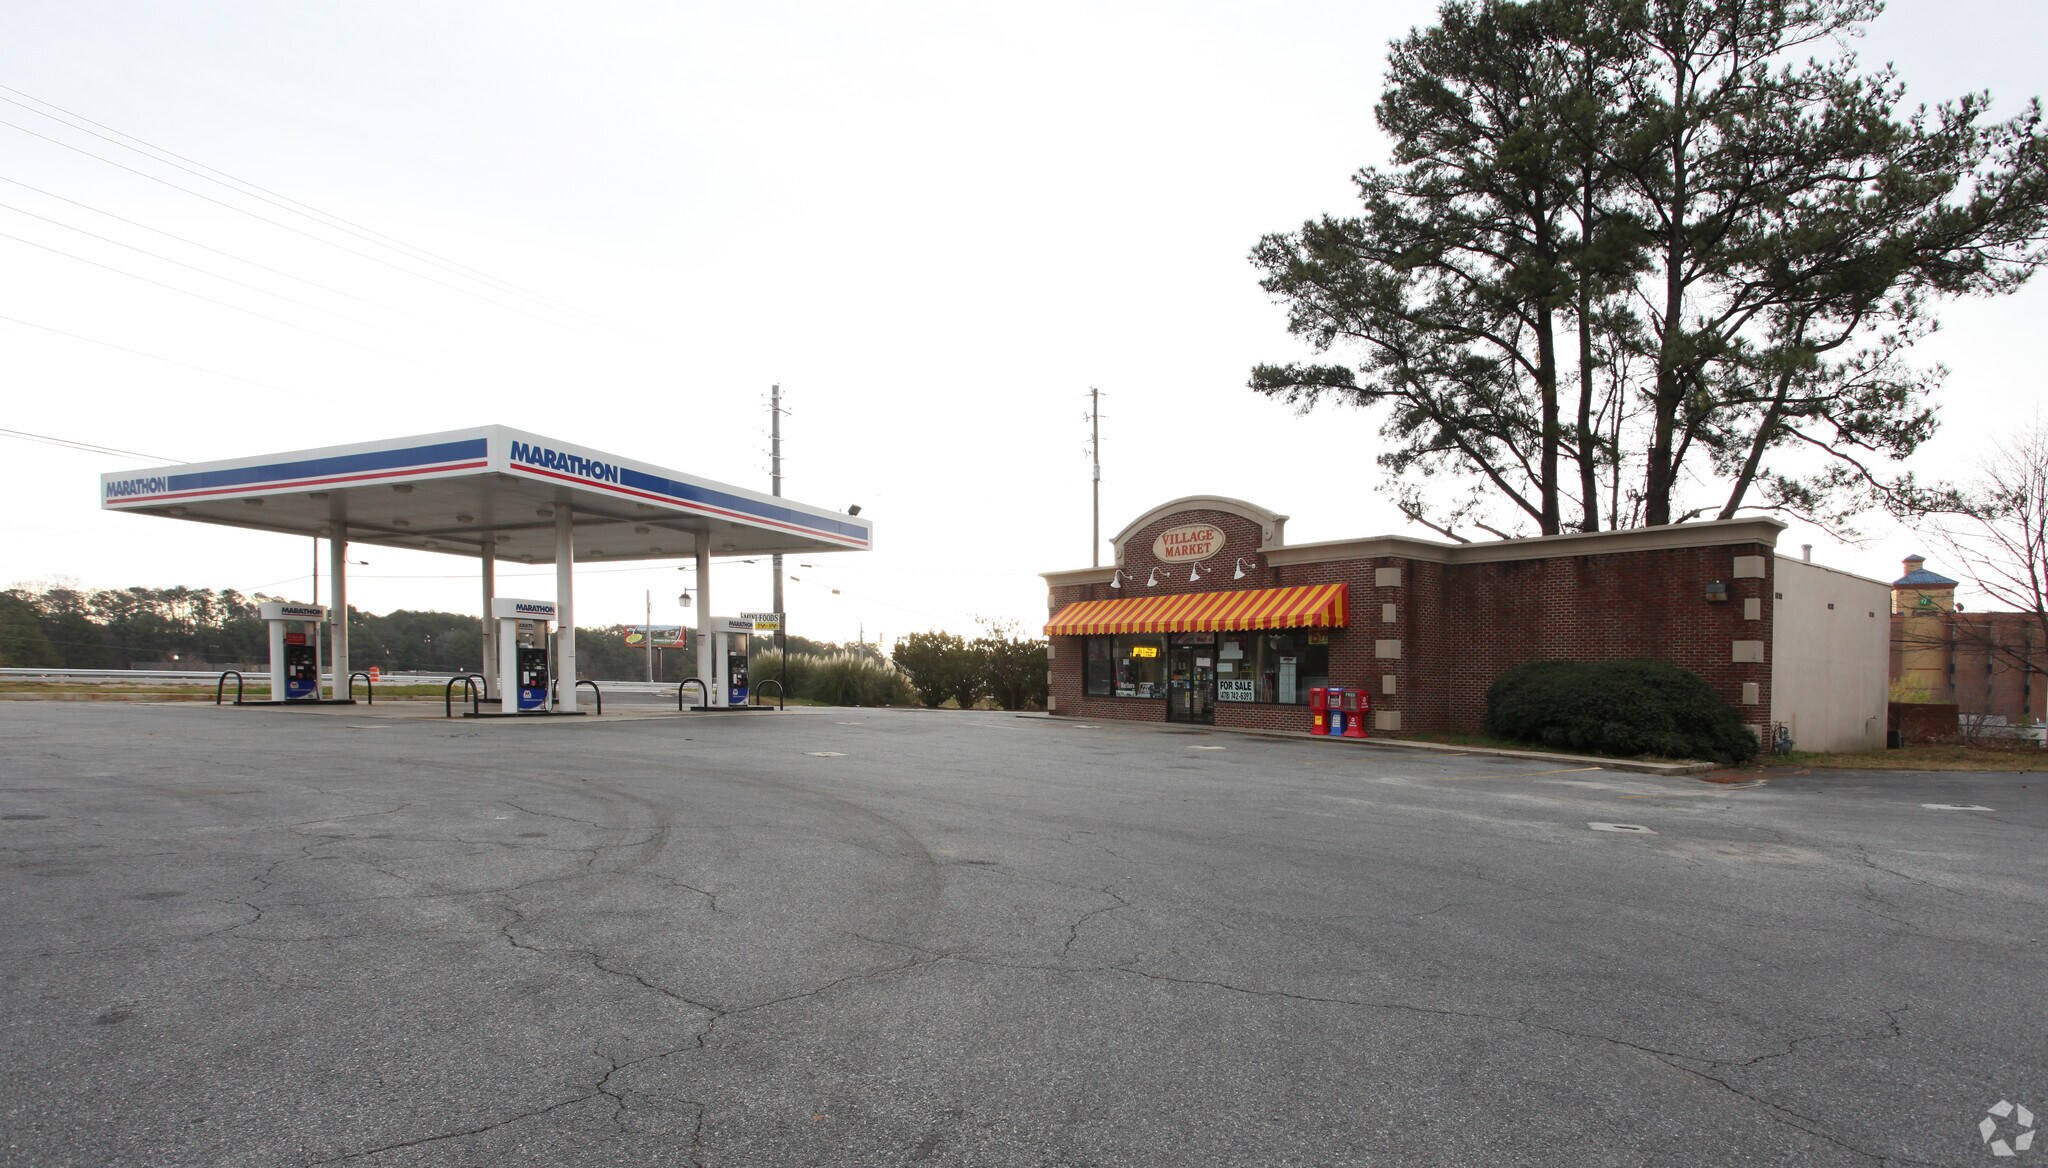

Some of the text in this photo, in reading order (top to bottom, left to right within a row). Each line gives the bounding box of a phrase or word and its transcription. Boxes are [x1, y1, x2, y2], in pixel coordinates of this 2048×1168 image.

[510, 440, 618, 484] MARATHON
[106, 476, 167, 498] MARATHON
[1161, 529, 1215, 545] VILLAGE
[1165, 542, 1212, 557] MARKET
[281, 607, 323, 615] MARATHON
[515, 603, 555, 613] MARATHON
[1220, 681, 1252, 691] FOR SALE
